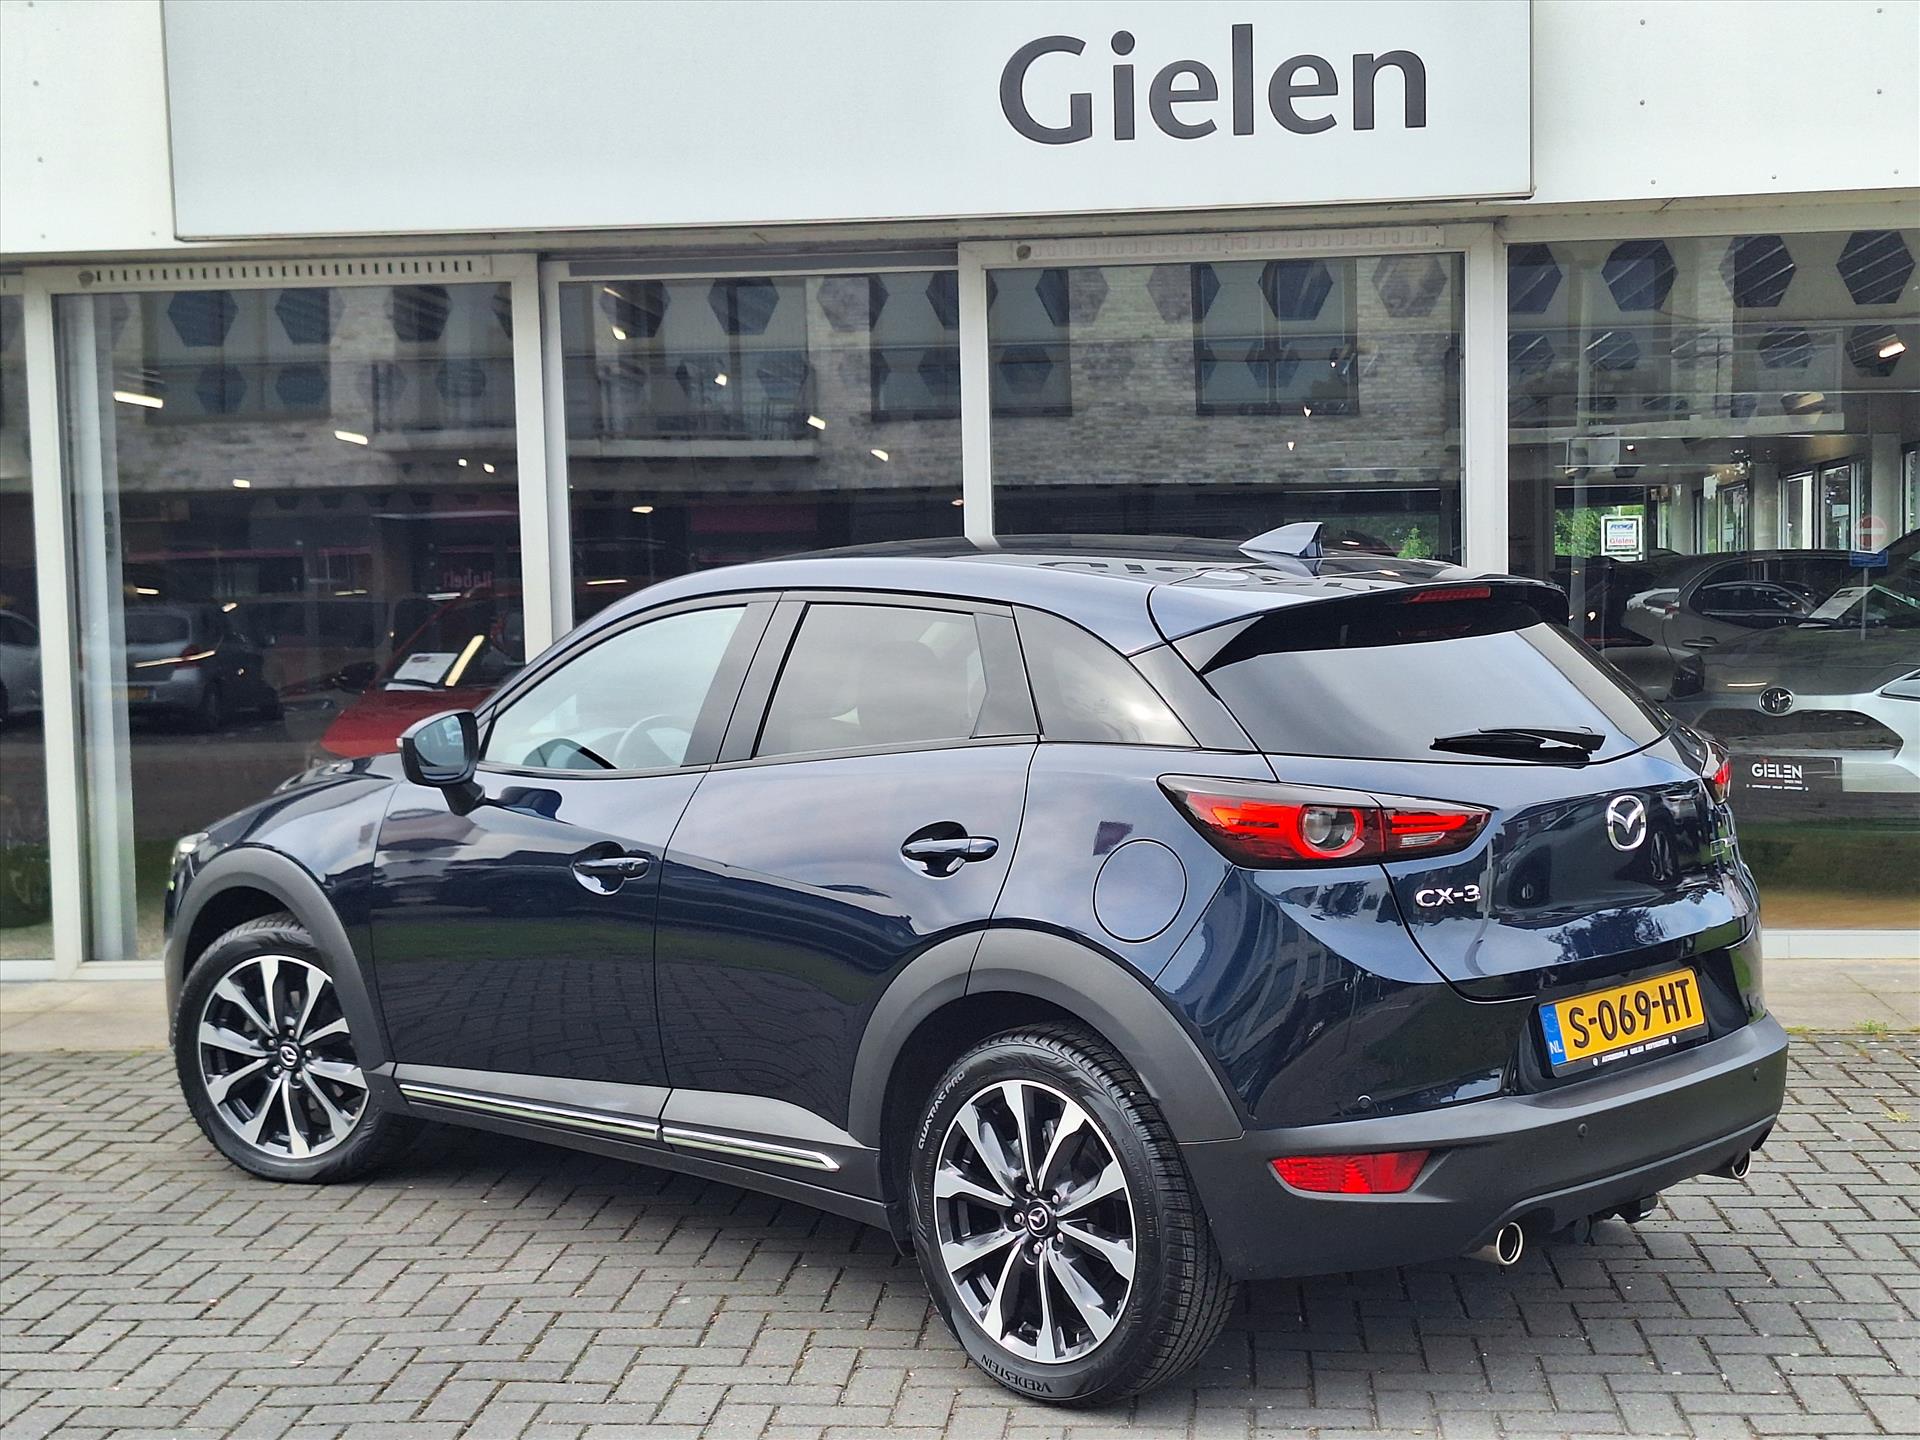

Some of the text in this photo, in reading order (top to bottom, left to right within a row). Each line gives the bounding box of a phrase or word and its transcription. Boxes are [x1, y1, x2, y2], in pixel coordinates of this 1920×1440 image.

[999, 23, 1427, 145] Gielen
[1751, 762, 1803, 779] GIELEN
[1415, 884, 1481, 908] CX-3
[1568, 978, 1692, 1049] S-069-HT
[1549, 1041, 1563, 1054] NL
[918, 1070, 966, 1150] QUATRAC PRO
[981, 1354, 1053, 1393] VREDESTEIN
